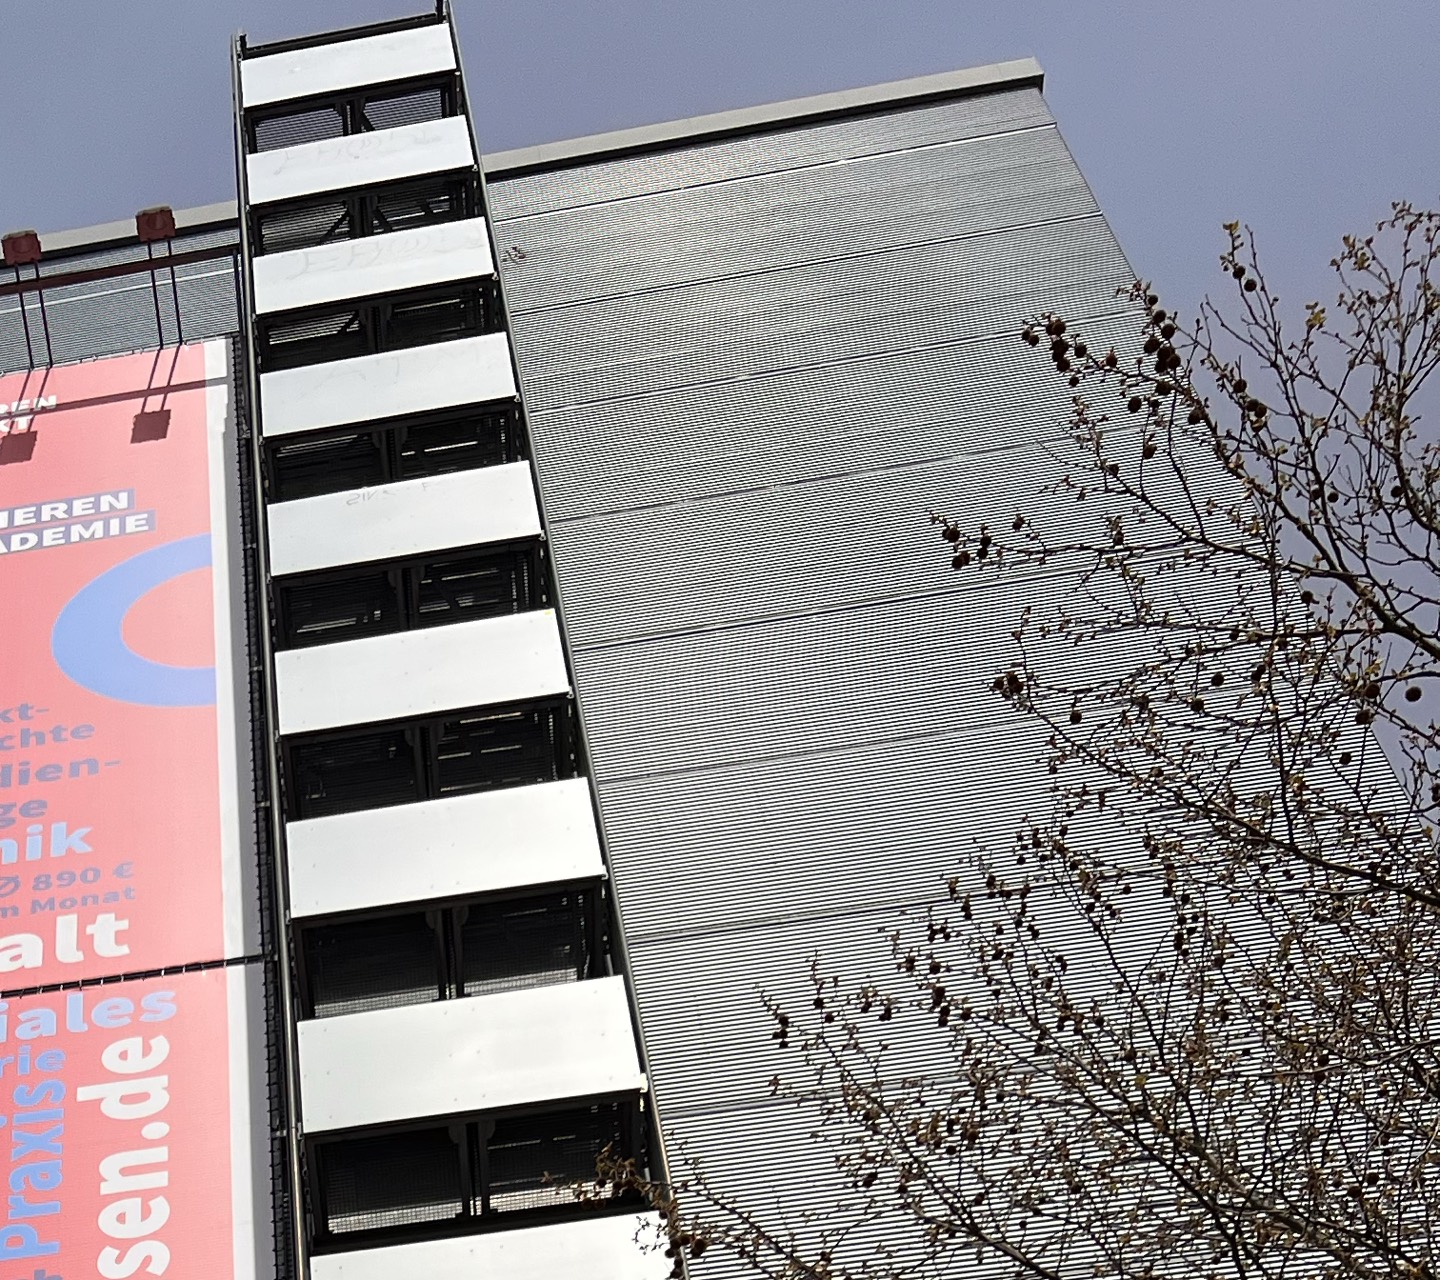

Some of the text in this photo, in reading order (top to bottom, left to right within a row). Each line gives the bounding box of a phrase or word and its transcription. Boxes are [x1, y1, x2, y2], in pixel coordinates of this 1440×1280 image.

[31, 866, 101, 891] 890
[112, 860, 134, 879] €
[30, 886, 136, 915] Monat
